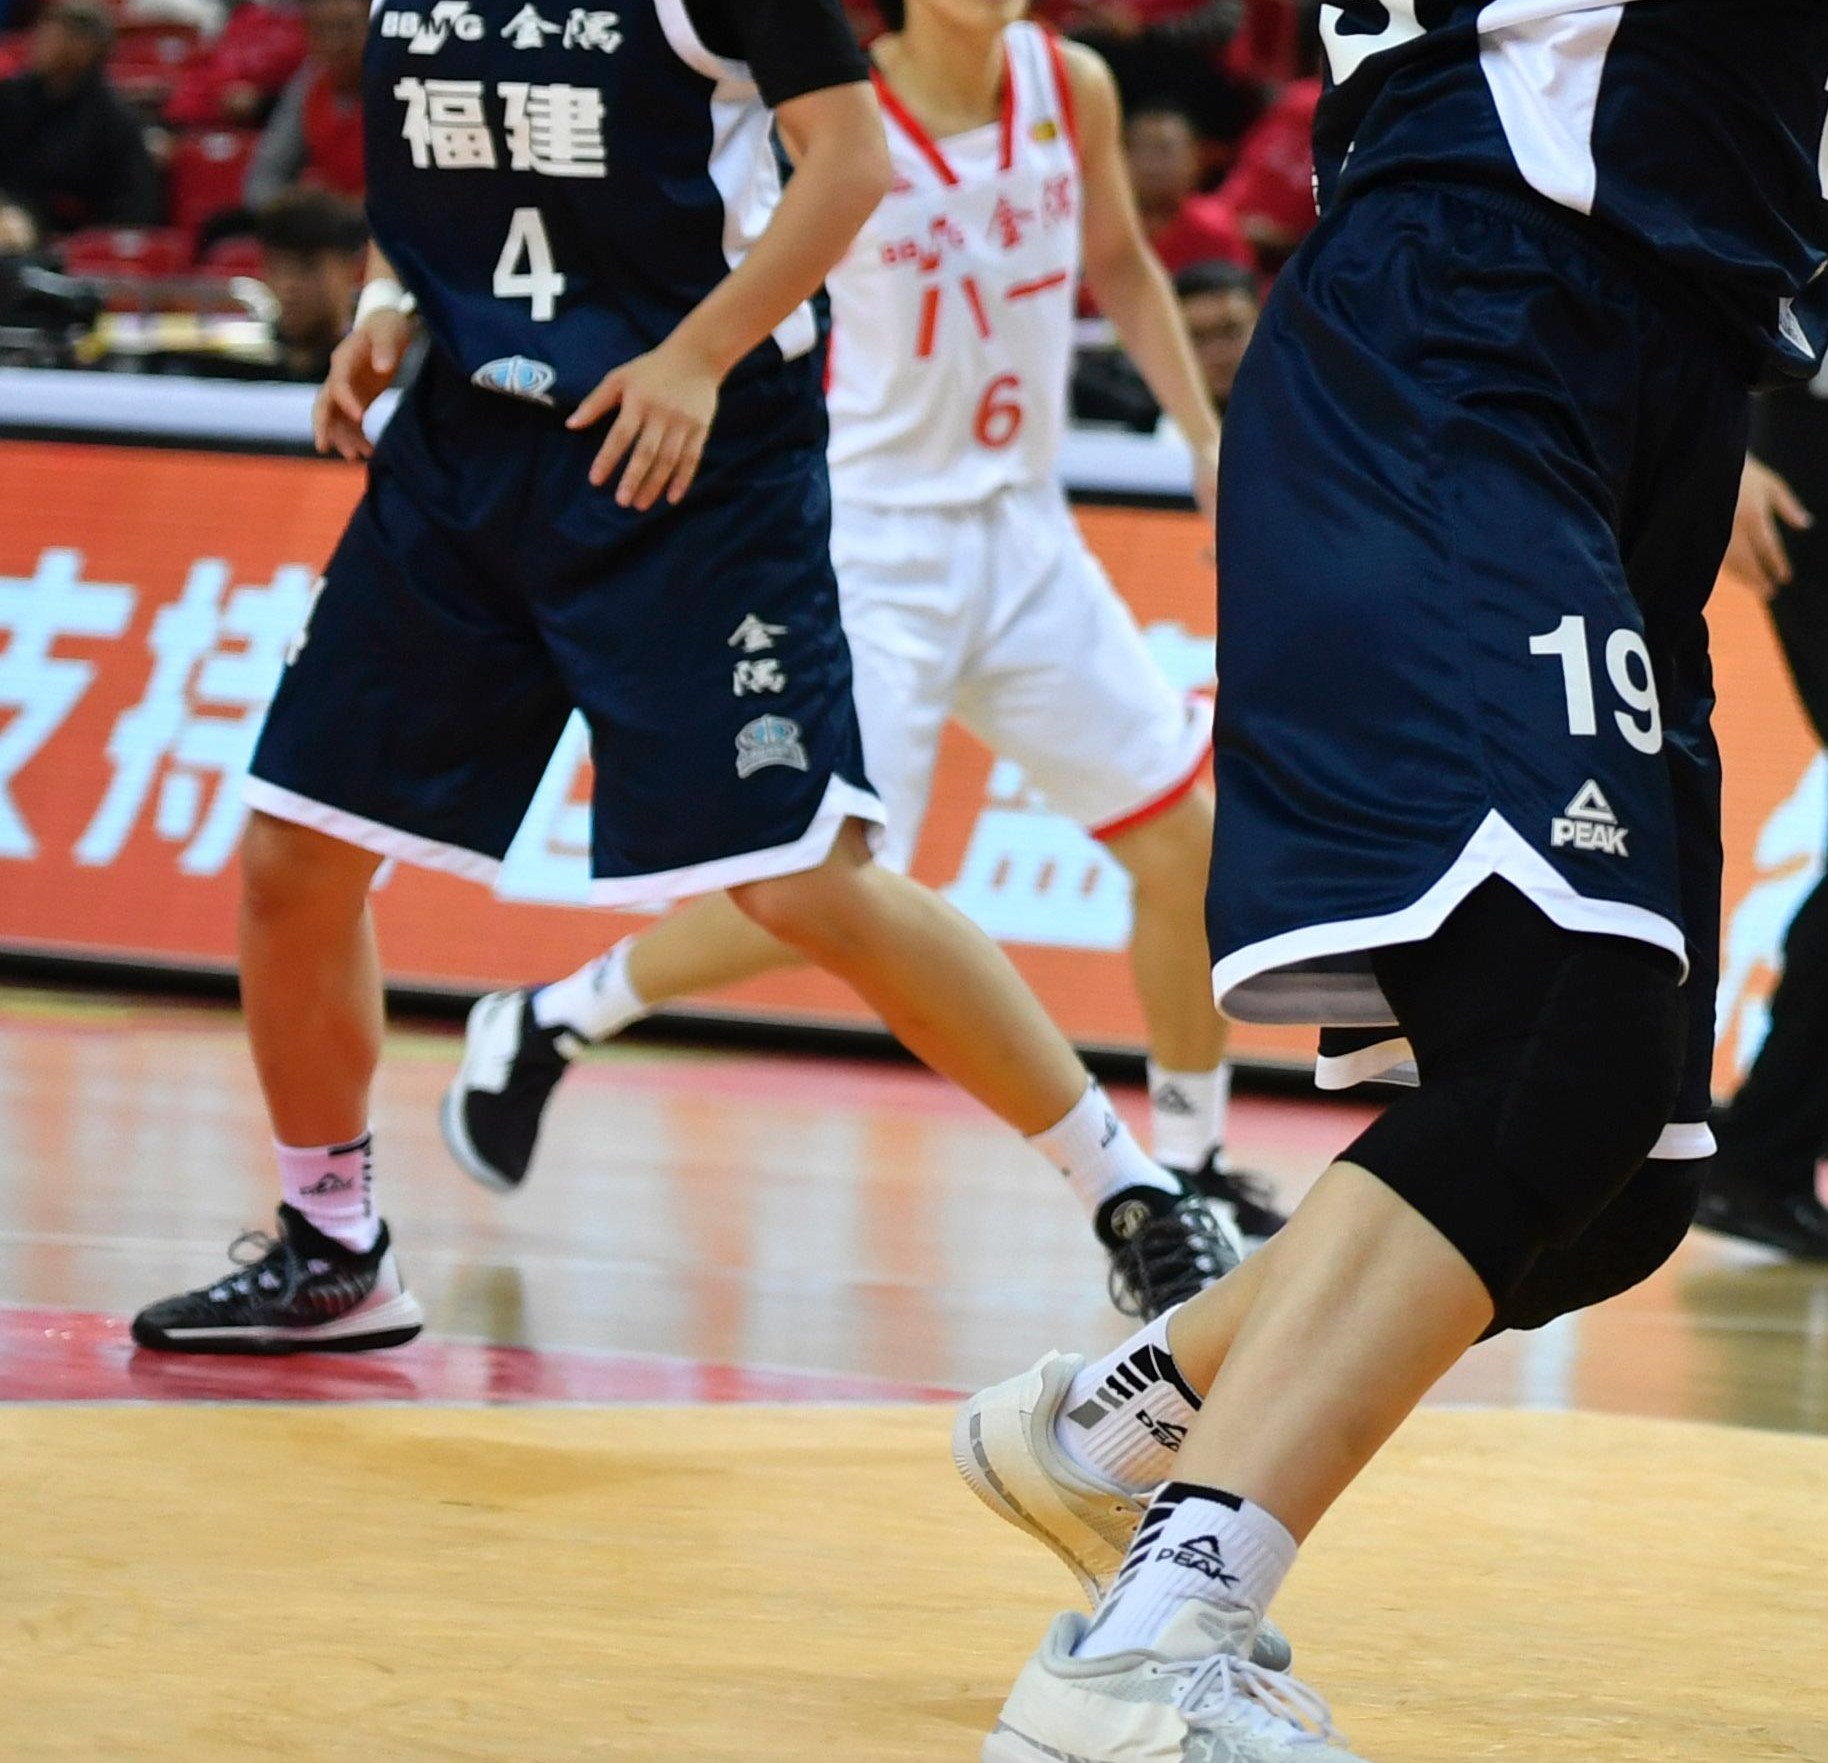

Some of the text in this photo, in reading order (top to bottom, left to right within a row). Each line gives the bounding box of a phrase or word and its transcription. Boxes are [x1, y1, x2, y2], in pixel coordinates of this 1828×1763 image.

[394, 76, 609, 178] 福建
[492, 206, 567, 322] 4
[972, 374, 1024, 451] 6
[1528, 614, 1663, 756] 19
[1550, 817, 1629, 858] PEAK
[1155, 1547, 1240, 1591] PEAK
